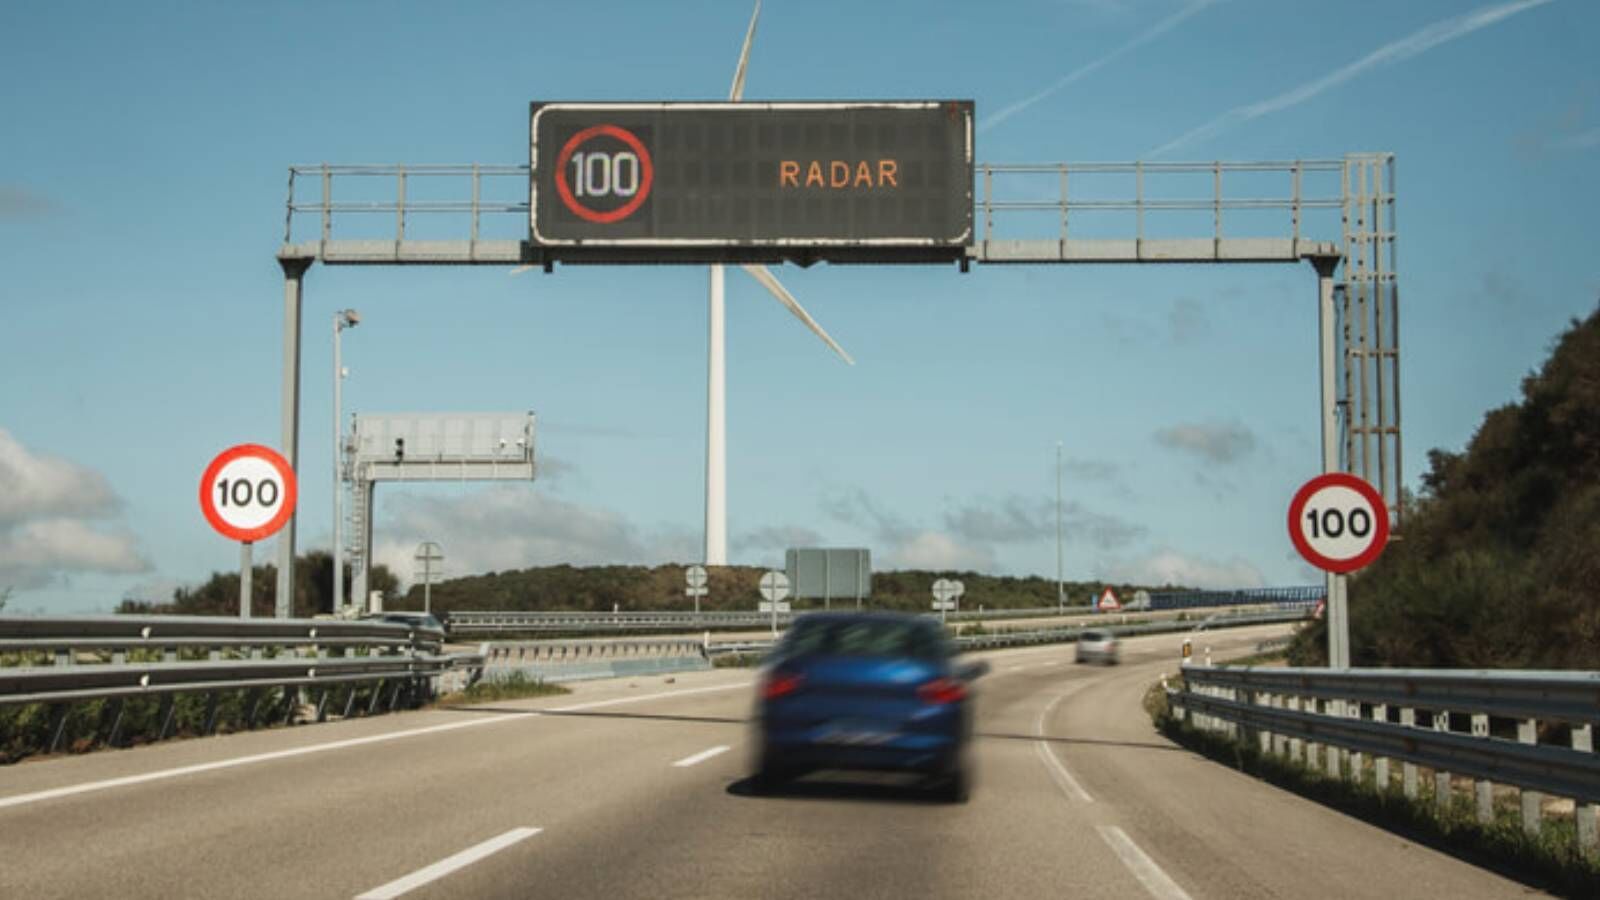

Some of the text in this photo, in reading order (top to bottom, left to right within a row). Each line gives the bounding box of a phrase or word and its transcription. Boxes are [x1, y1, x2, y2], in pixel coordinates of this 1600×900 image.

[571, 151, 638, 197] 100
[779, 159, 898, 188] RADAR
[216, 478, 279, 507] 100
[1306, 507, 1371, 539] 100
